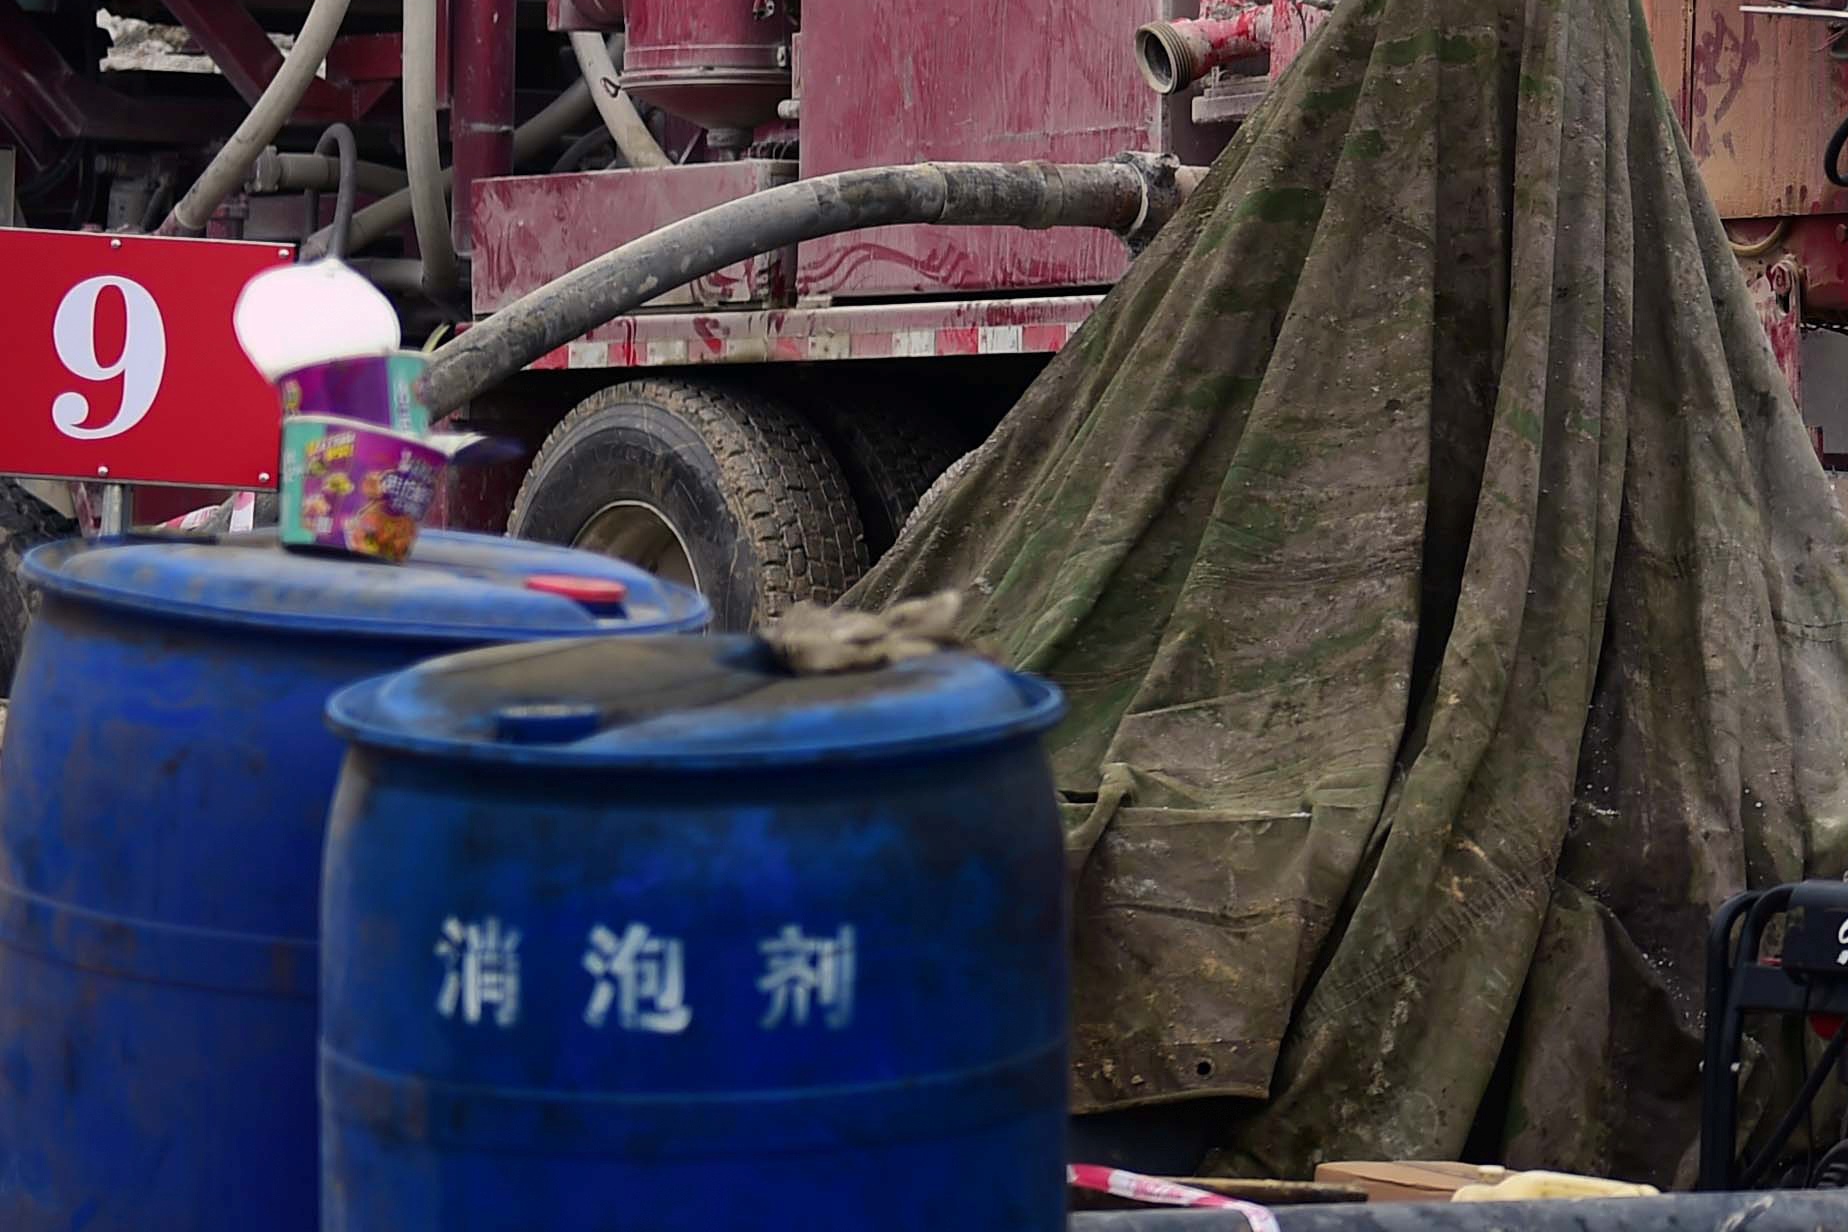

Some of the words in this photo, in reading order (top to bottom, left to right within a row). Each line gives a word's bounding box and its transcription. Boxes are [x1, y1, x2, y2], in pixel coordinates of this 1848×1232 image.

[53, 275, 166, 440] 9
[433, 916, 856, 1034] 消泡剂
